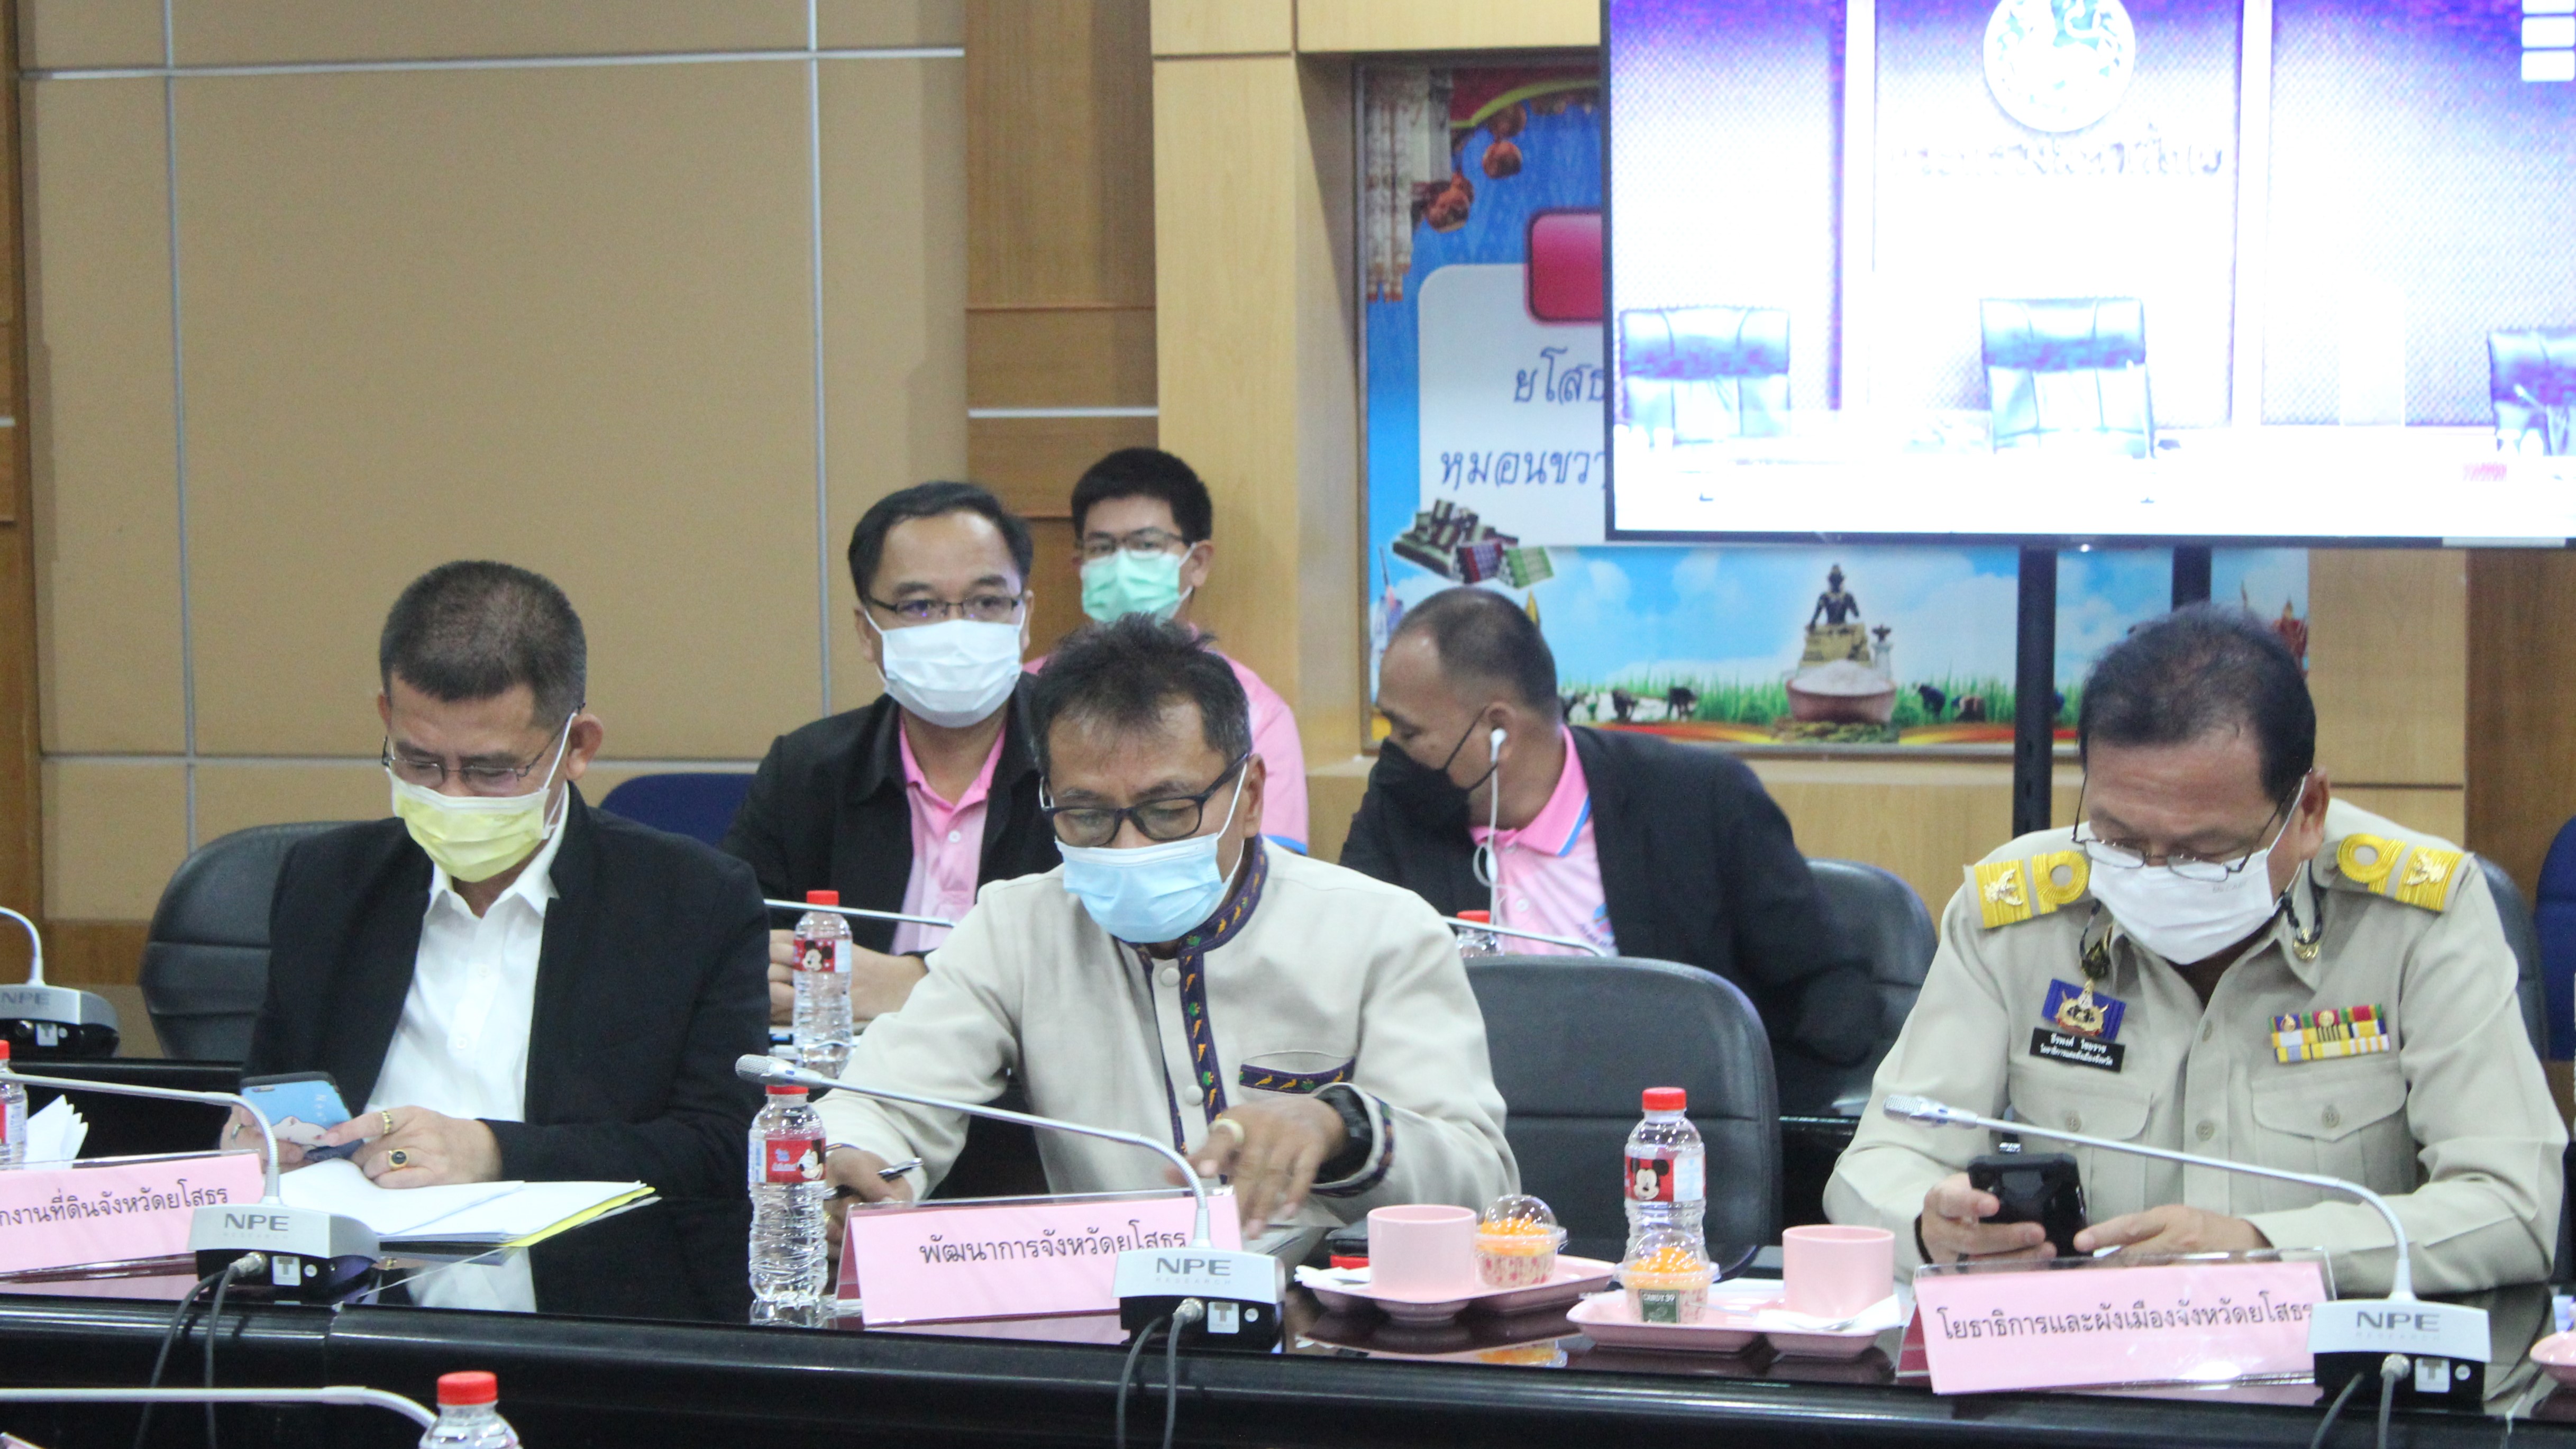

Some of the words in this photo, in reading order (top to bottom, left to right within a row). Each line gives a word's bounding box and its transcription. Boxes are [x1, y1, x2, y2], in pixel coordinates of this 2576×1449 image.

[225, 1213, 289, 1231] NPE
[919, 1219, 1186, 1263] พัฒนาการจังหวัดยโสธร
[1156, 1257, 1232, 1276] NPE
[2356, 1311, 2440, 1332] NPE
